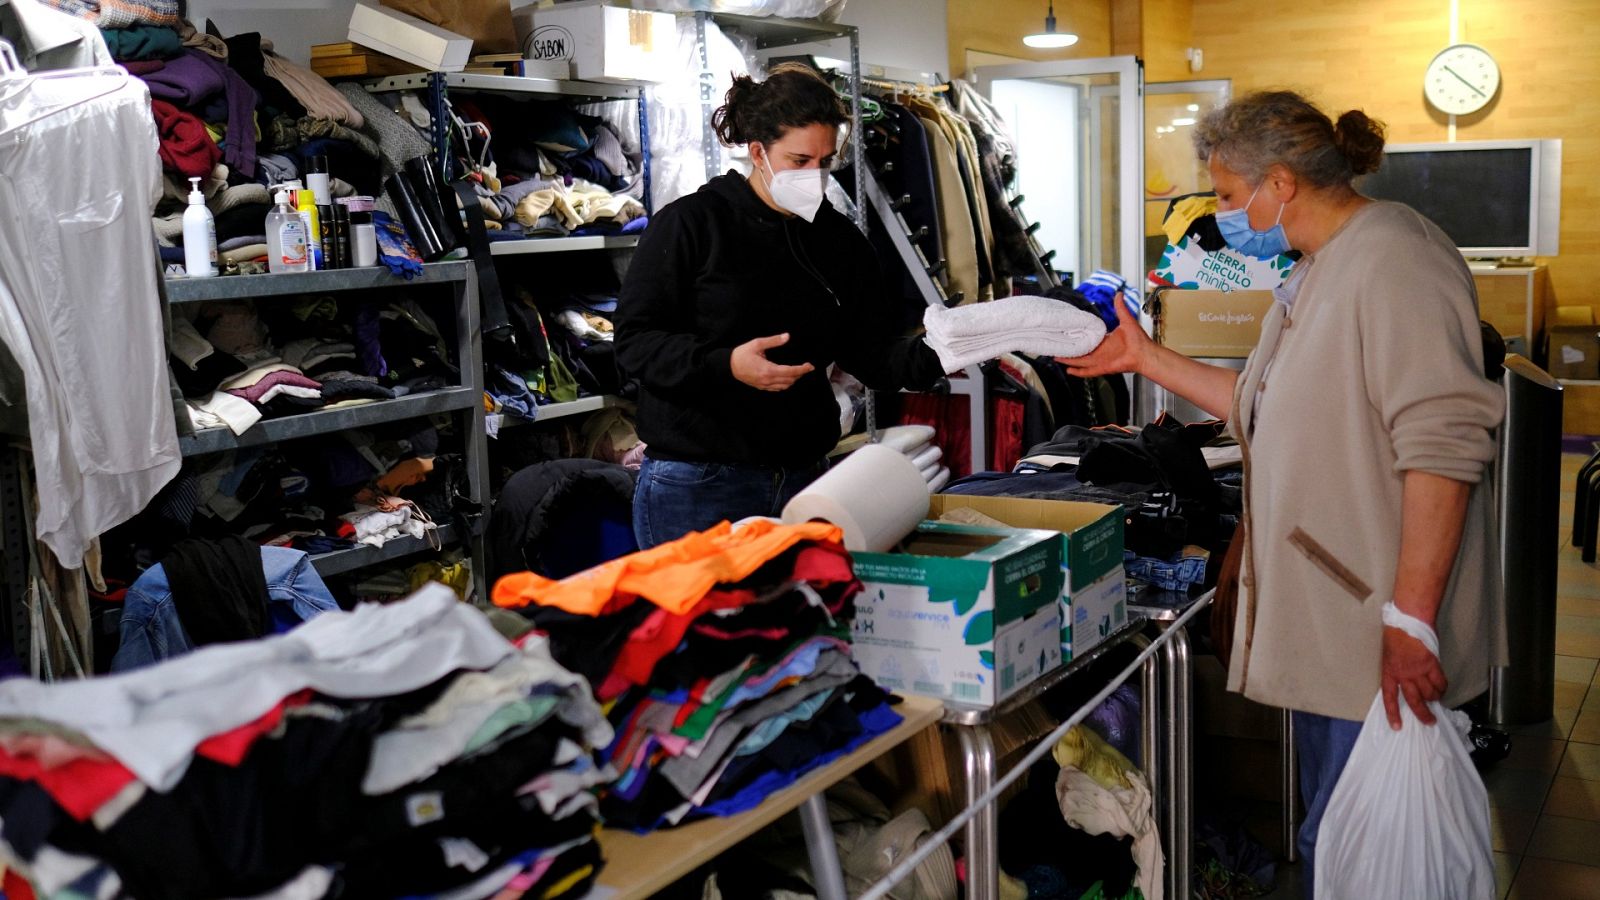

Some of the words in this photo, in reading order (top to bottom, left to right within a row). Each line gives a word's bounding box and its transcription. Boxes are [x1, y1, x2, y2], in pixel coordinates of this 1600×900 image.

[534, 38, 565, 60] SABON
[1207, 250, 1246, 274] CIERRA
[1195, 270, 1235, 293] minib
